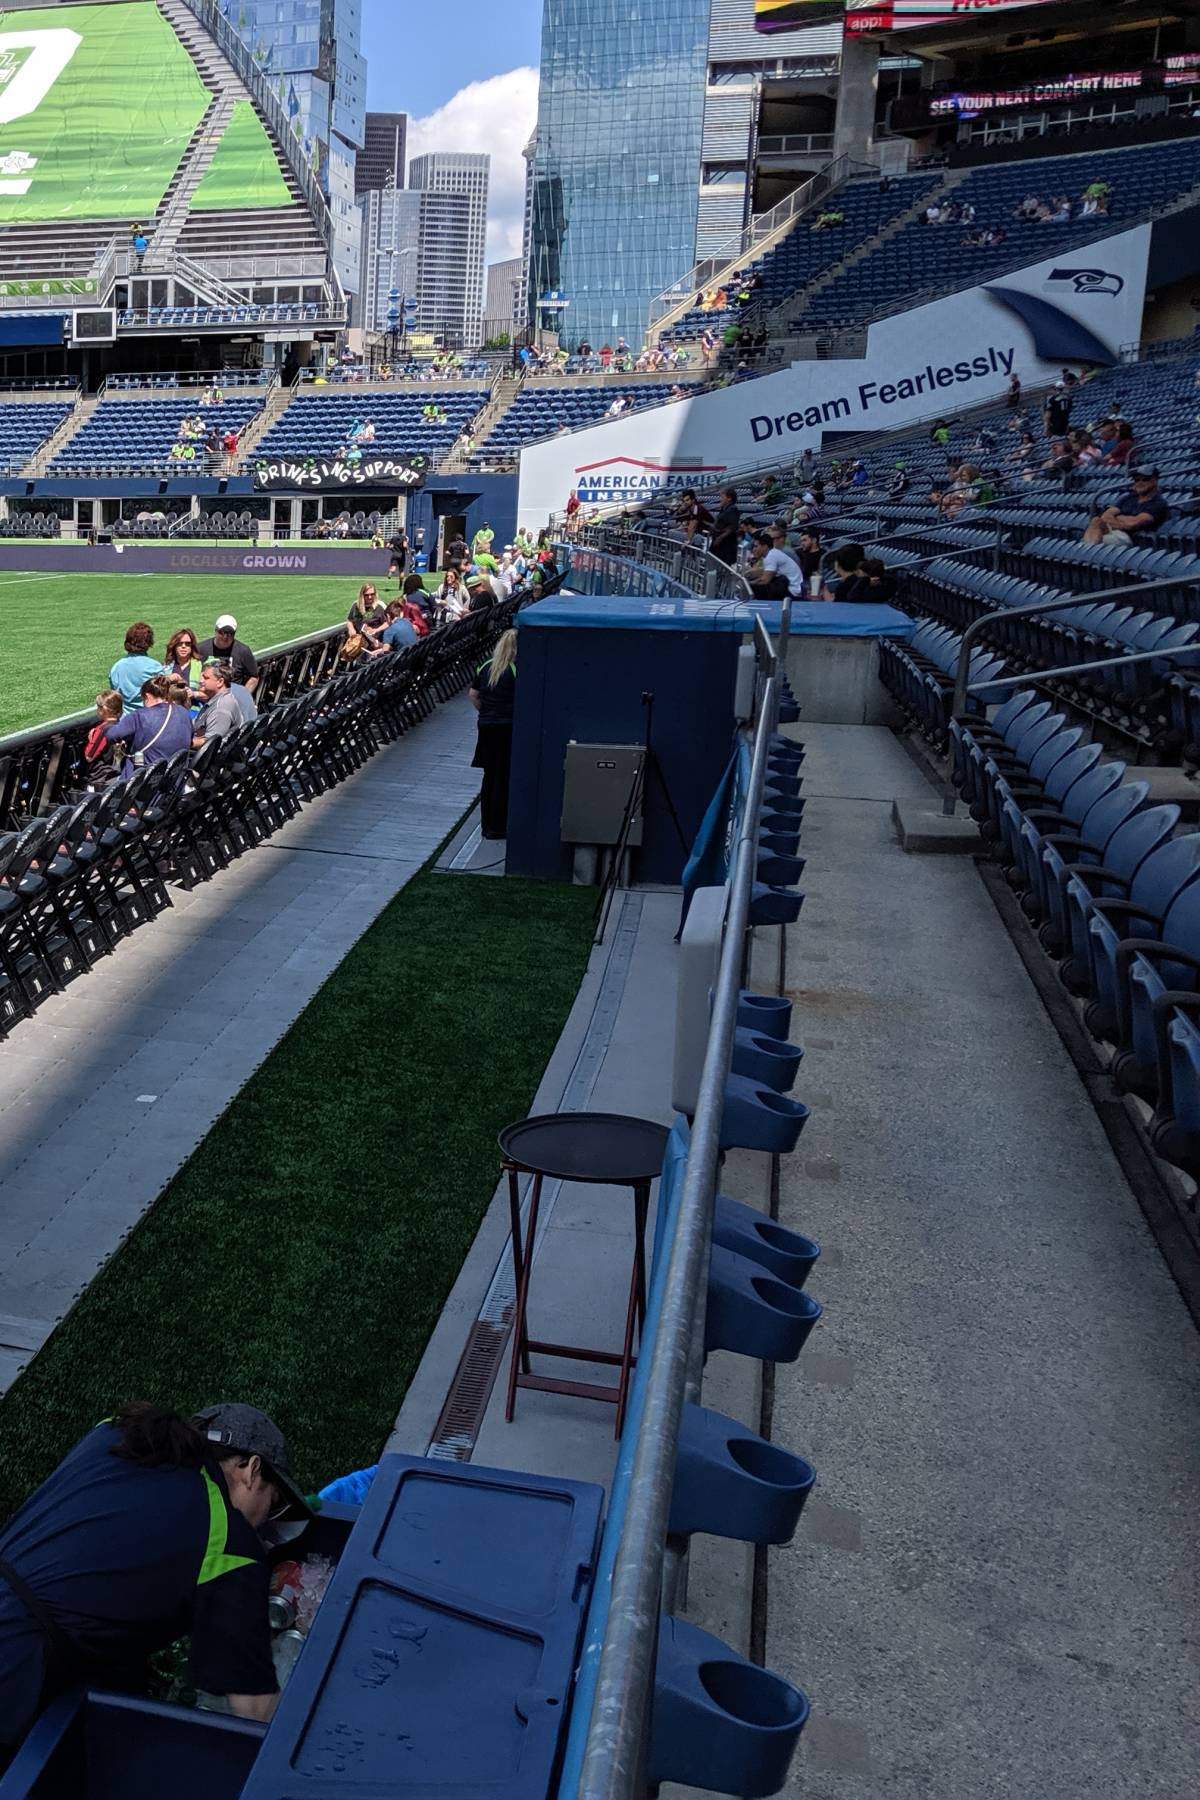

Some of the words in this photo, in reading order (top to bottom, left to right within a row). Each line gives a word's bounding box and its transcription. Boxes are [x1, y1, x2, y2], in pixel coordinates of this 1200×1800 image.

[1034, 77, 1101, 100] CONCERT
[750, 396, 852, 443] Dream
[858, 347, 1015, 411] Fearlessly
[578, 476, 660, 488] AMERICAN
[243, 555, 306, 568] GROWN
